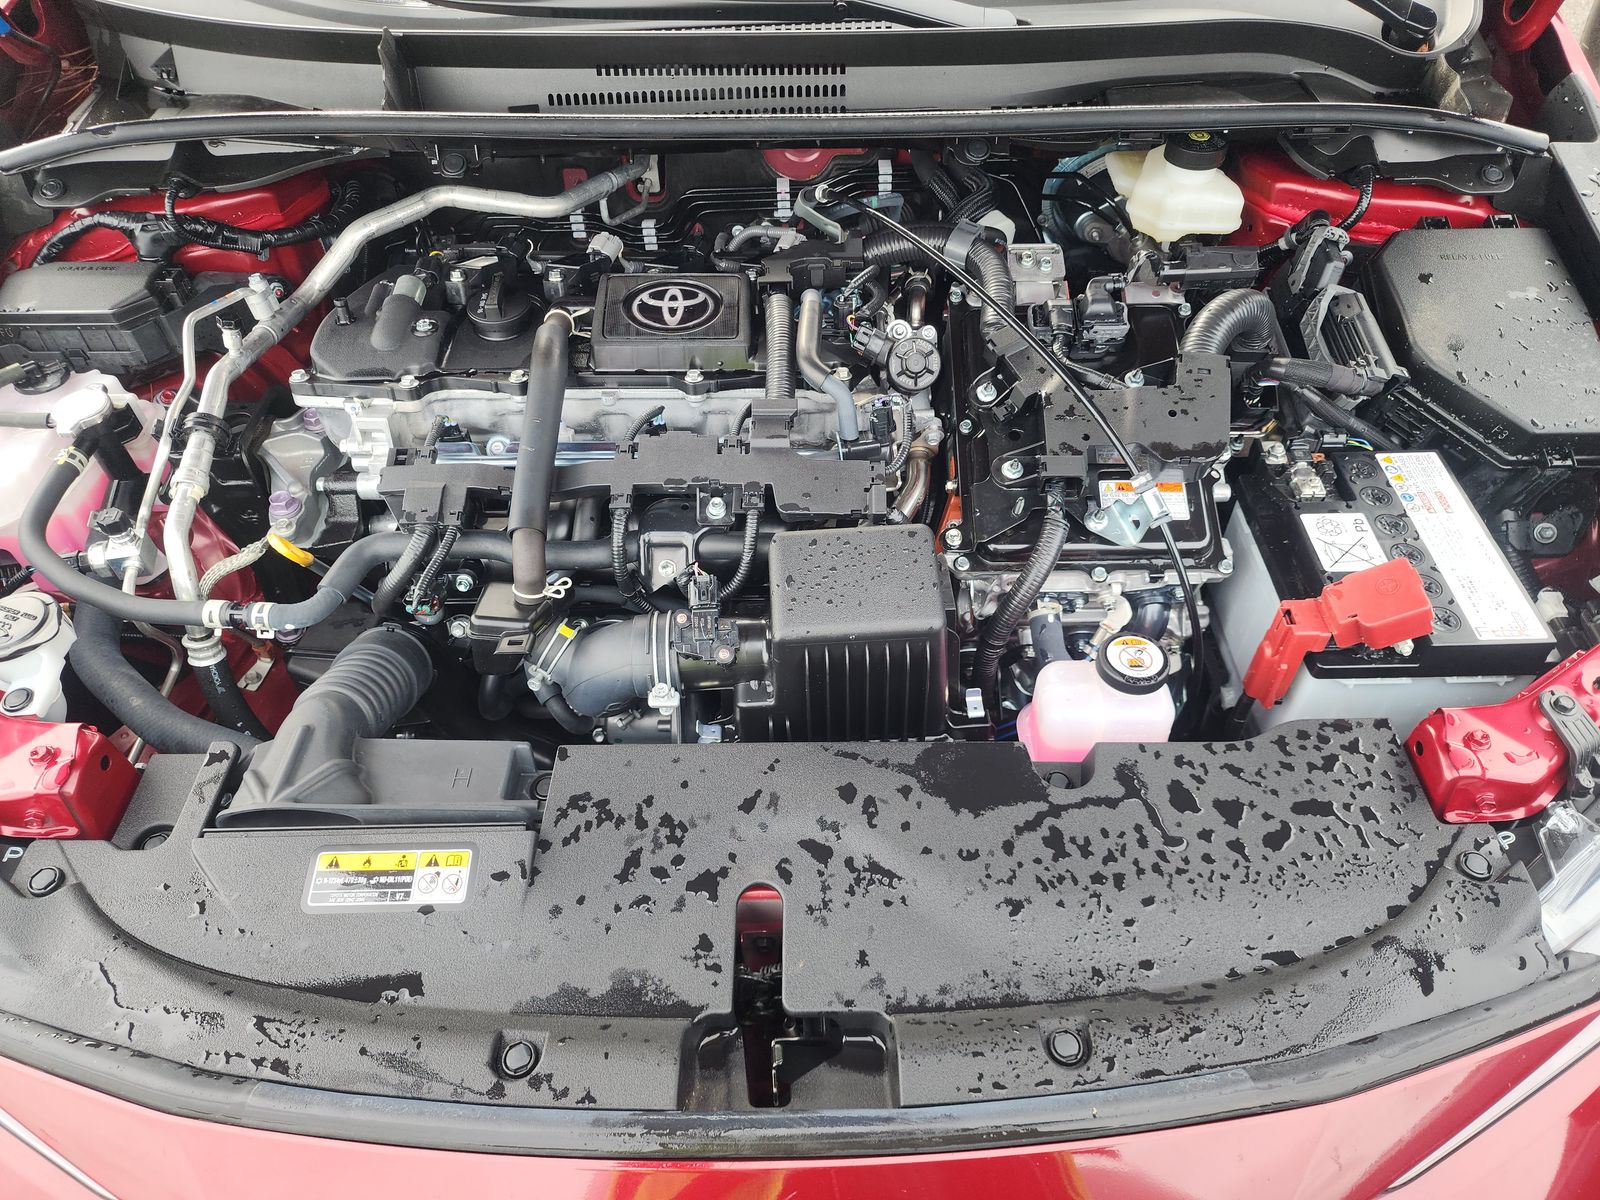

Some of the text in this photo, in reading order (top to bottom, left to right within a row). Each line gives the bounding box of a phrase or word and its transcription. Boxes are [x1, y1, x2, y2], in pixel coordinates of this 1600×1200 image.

[1353, 518, 1369, 532] Pb
[451, 767, 473, 788] H
[1497, 831, 1516, 850] P
[2, 846, 24, 862] P
